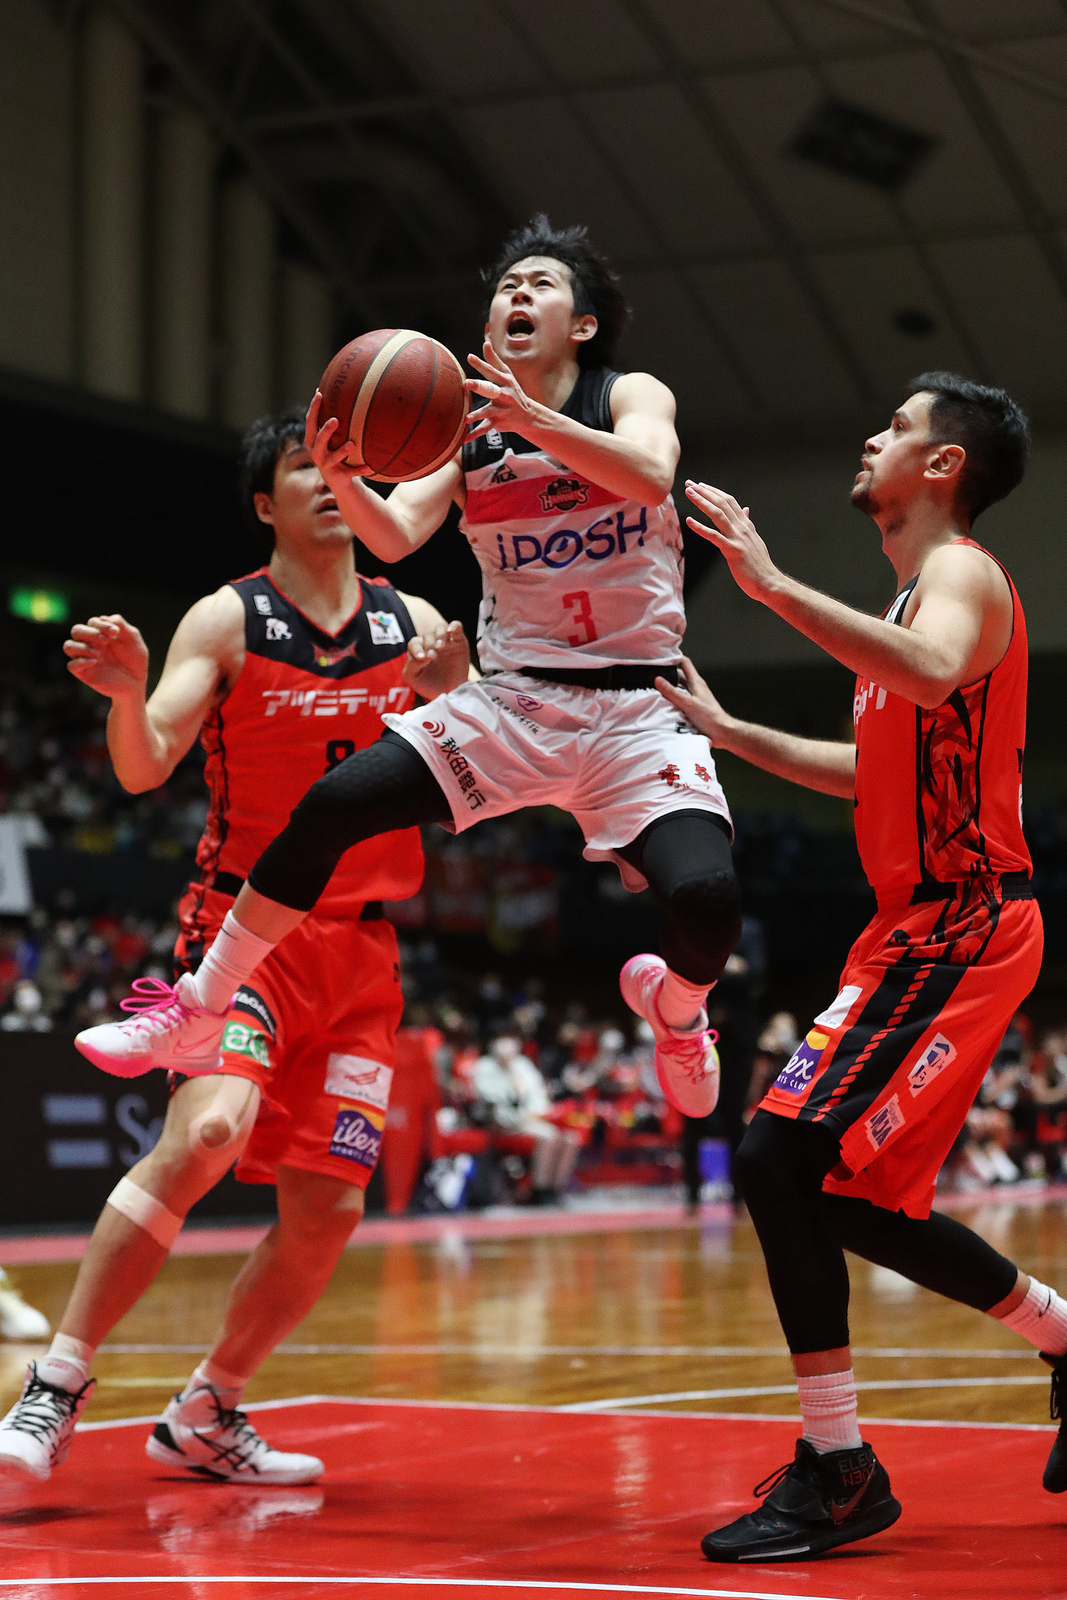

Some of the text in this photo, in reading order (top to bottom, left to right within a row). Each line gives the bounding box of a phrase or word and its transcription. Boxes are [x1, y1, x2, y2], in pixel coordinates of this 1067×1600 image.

[561, 590, 598, 647] 3
[261, 686, 412, 717] アツミテック
[439, 737, 487, 811] 秋田銀行
